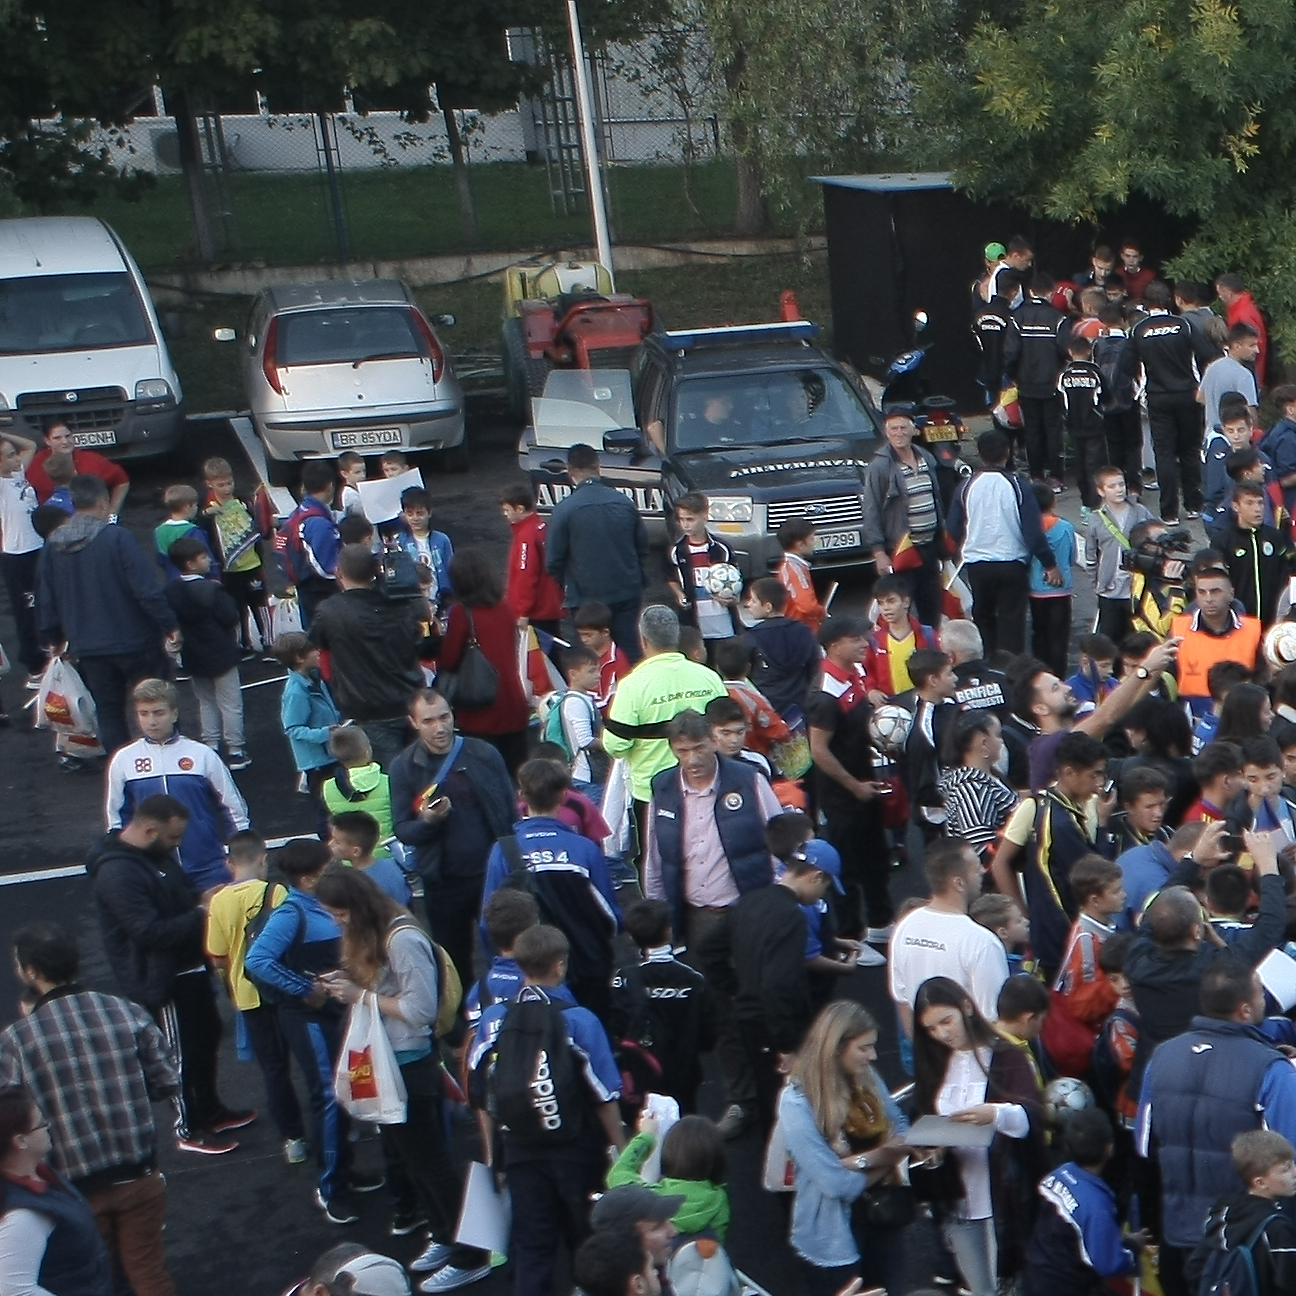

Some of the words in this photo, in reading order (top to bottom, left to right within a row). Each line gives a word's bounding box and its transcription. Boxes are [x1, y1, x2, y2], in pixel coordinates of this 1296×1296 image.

[1143, 325, 1182, 338] ASDC
[341, 433, 357, 445] BR
[819, 533, 855, 548] 17299
[134, 757, 152, 773] 88
[557, 850, 569, 864] 4
[904, 936, 946, 951] DIADORA
[528, 1048, 562, 1131] adidas
